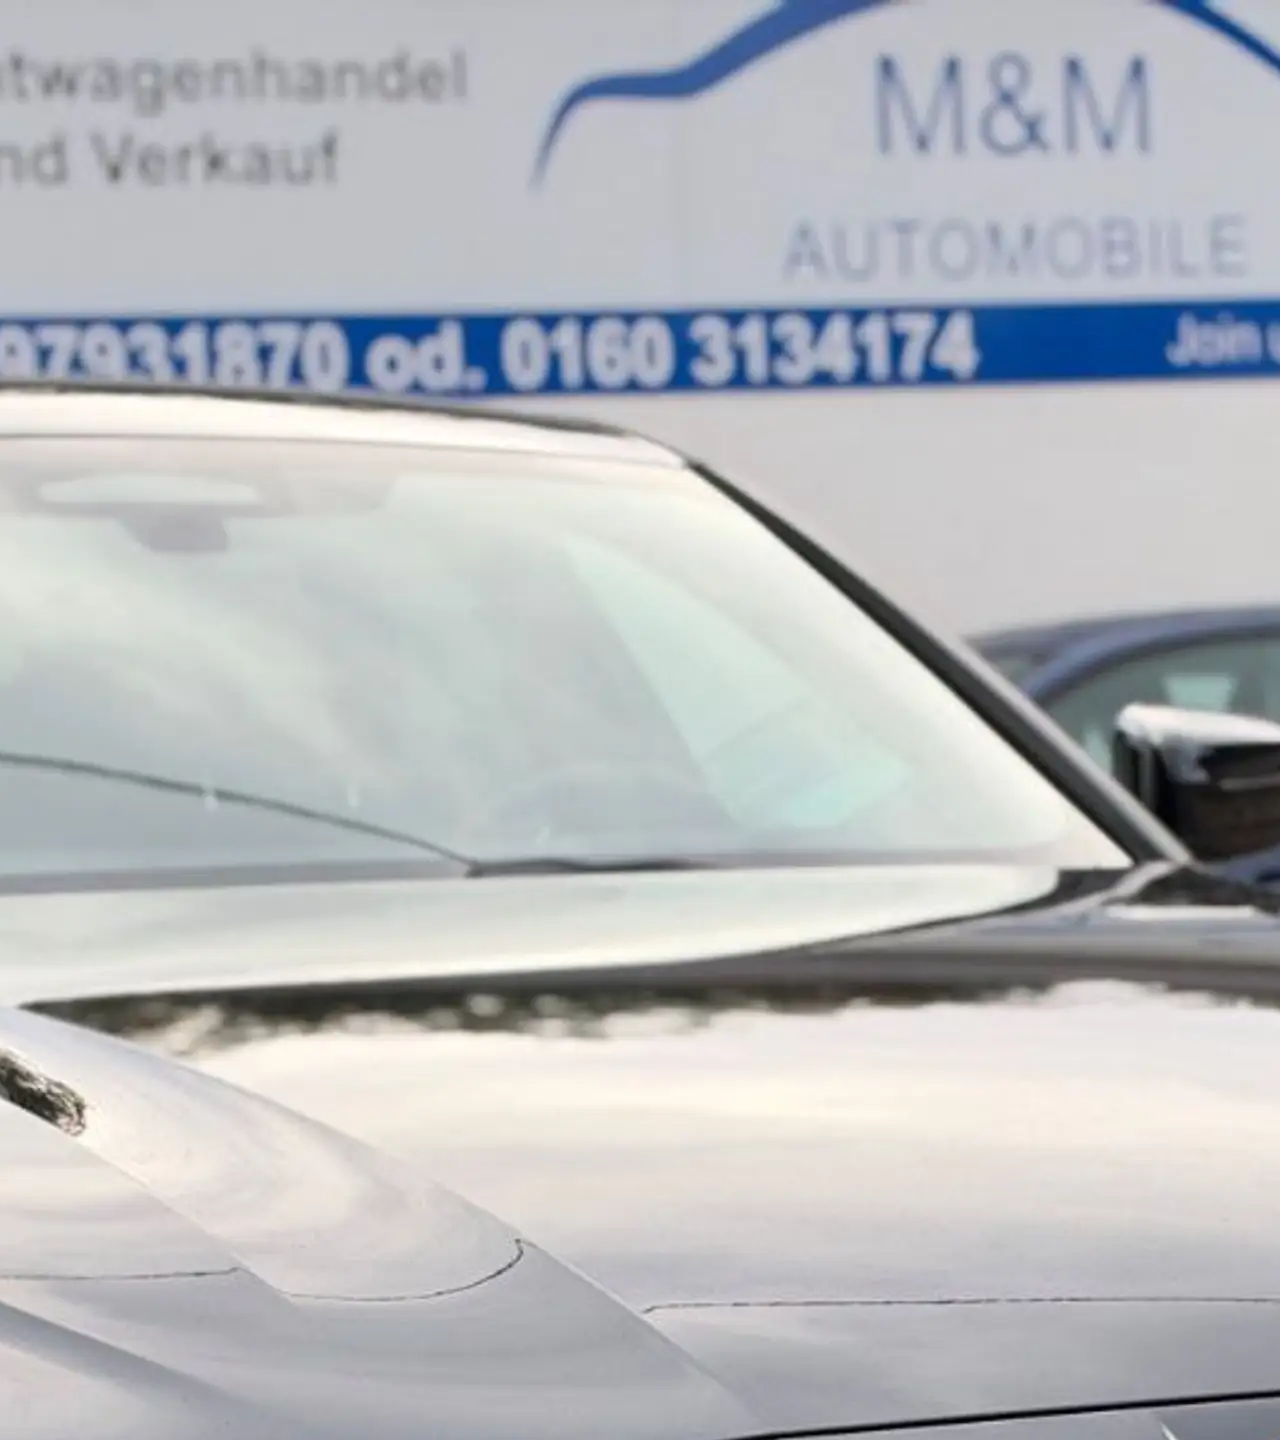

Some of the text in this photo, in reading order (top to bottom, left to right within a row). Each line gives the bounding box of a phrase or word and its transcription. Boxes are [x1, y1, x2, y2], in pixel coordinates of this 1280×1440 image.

[873, 50, 1154, 156] M&M
[92, 130, 341, 188] Verkauf
[783, 214, 1249, 282] AUTOMOBILE
[365, 318, 488, 391] od.
[500, 315, 675, 390] 0160
[687, 309, 980, 386] 3134174
[1165, 310, 1261, 367] Join
